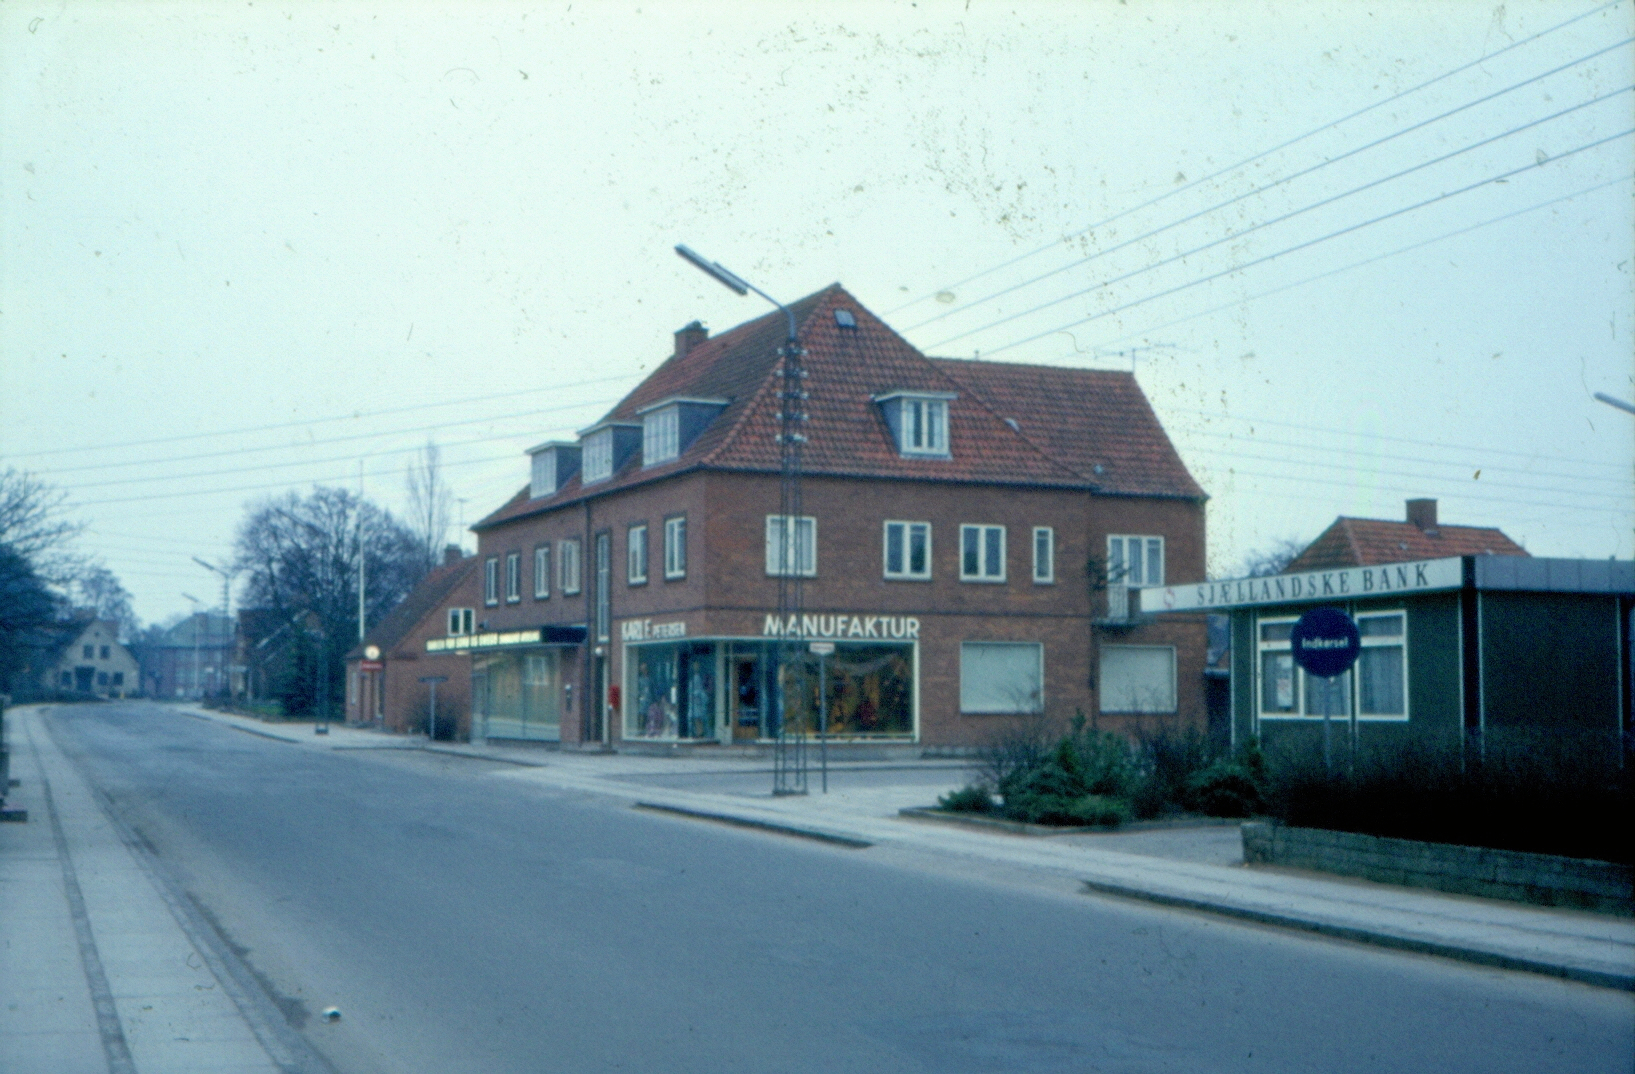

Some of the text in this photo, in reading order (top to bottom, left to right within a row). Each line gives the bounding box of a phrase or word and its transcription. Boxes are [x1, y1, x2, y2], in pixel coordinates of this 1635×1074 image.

[1196, 562, 1431, 606] SJÆLLANDSKE BANK
[763, 613, 920, 639] MANUFAKTUR
